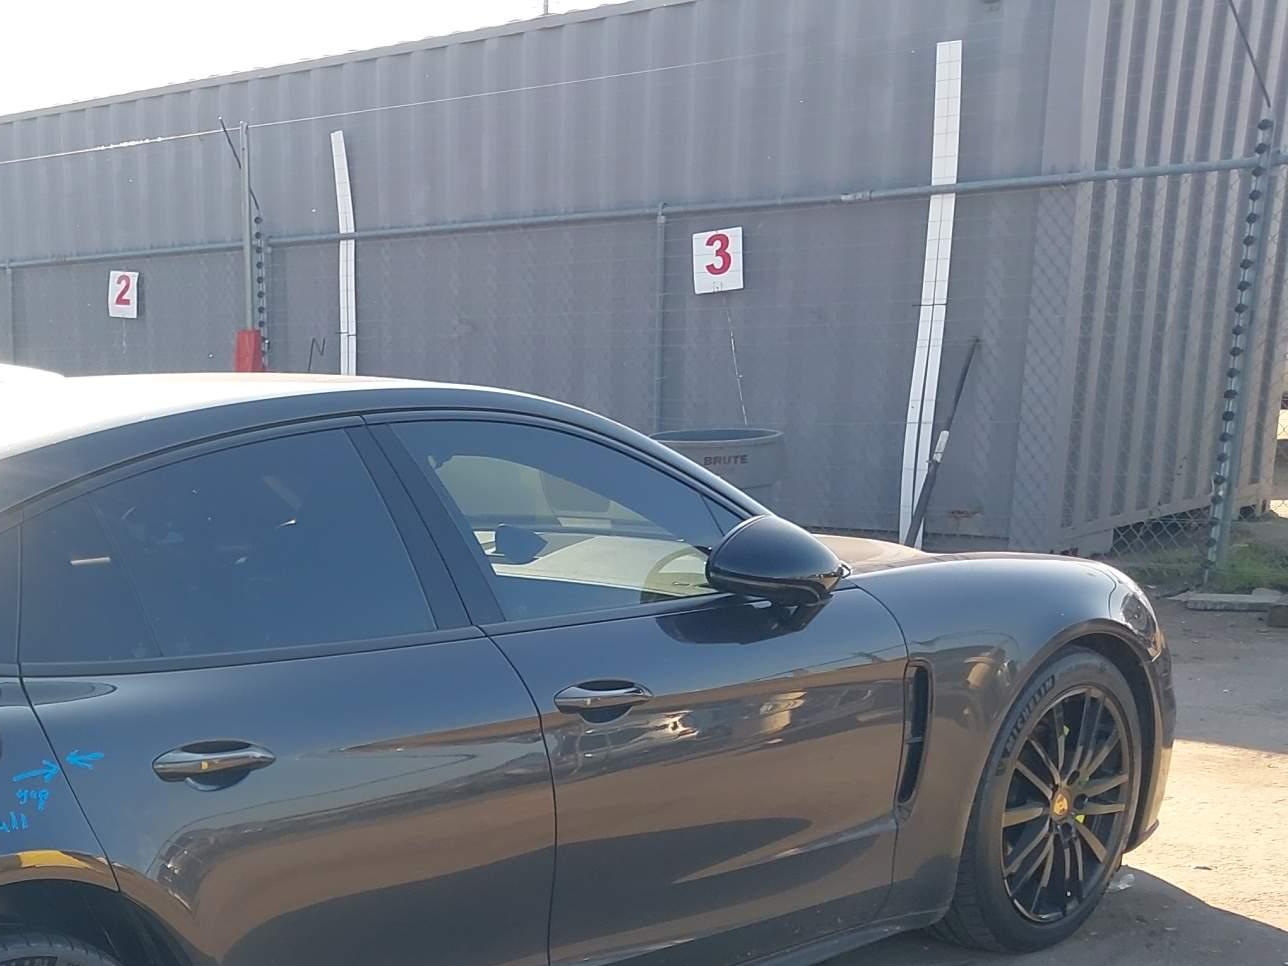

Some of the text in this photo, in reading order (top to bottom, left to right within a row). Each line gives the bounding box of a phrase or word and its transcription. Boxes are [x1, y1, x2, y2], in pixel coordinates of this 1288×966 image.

[706, 233, 731, 275] 3
[116, 274, 130, 305] 2
[703, 454, 749, 466] BRUTE
